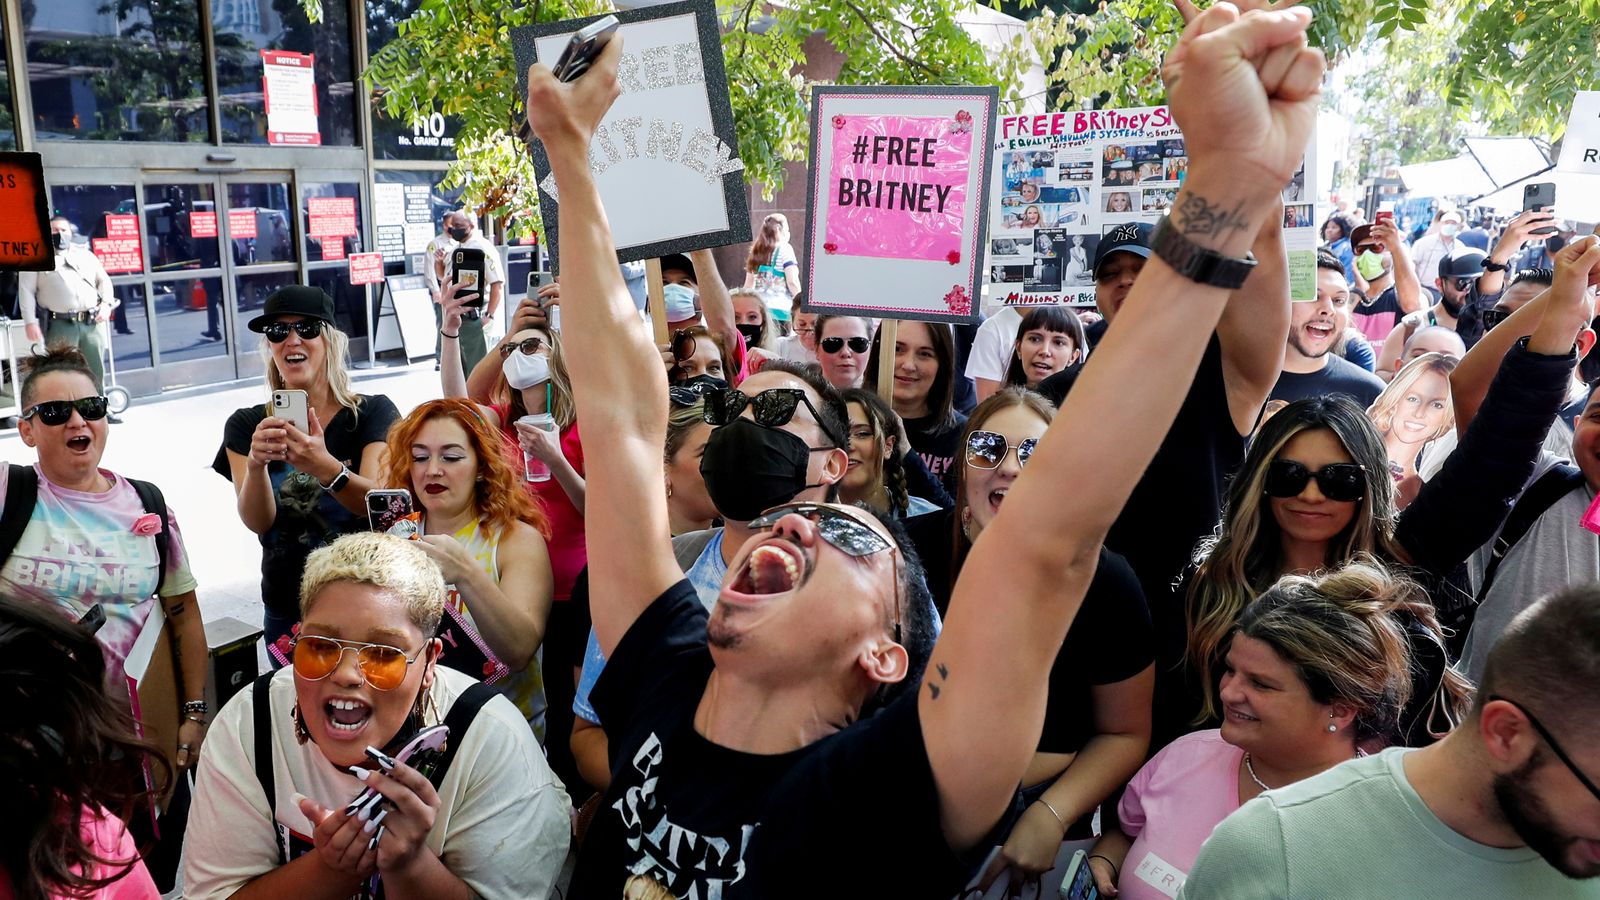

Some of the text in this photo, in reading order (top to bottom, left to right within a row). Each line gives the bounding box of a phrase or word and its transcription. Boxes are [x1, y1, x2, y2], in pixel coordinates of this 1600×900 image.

[276, 56, 301, 66] NOTICE
[617, 42, 705, 94] REE
[1003, 113, 1065, 139] FREE
[413, 136, 440, 147] GRAND
[852, 135, 938, 167] #FREE
[1583, 148, 1600, 163] R
[838, 177, 952, 214] BRITNEY
